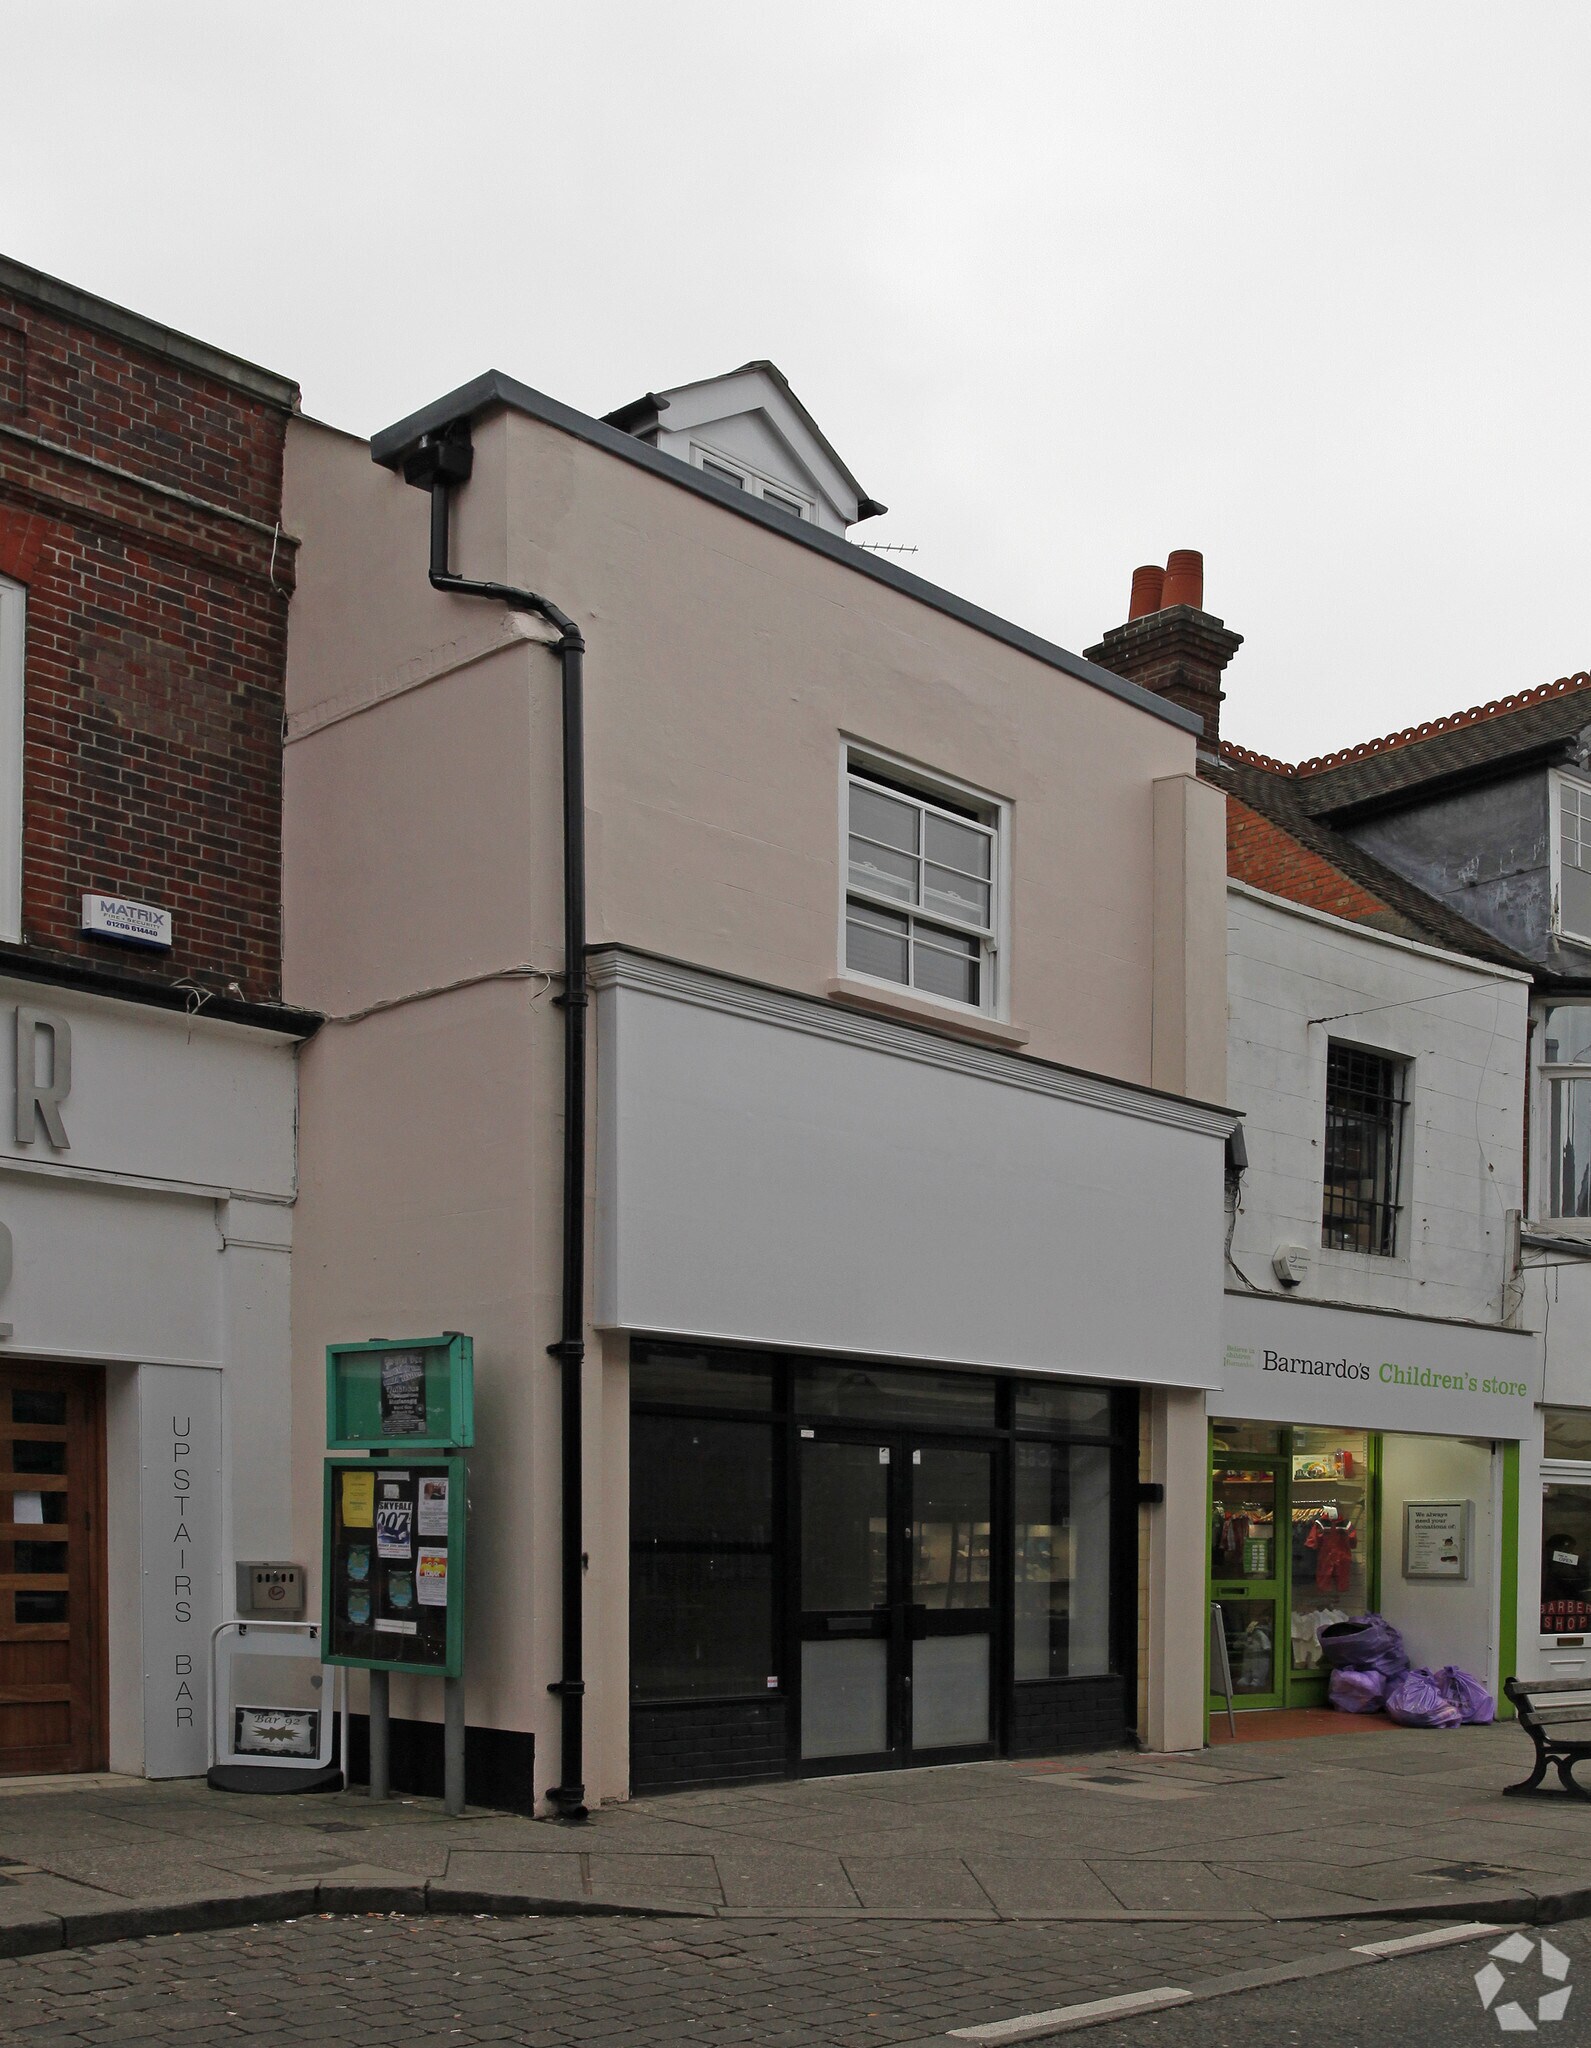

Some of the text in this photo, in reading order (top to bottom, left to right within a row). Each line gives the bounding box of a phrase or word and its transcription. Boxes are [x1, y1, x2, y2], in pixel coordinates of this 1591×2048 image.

[100, 900, 164, 926] MATRIX
[127, 918, 161, 929] SECURITY
[1262, 1349, 1527, 1397] Barnardo's Children's store
[379, 1501, 412, 1511] SKYFALL
[378, 1511, 410, 1530] 007
[172, 1415, 194, 1728] UPSTAIRS BAR
[1544, 1616, 1588, 1631] SHOP
[254, 1713, 301, 1727] Bar 92
